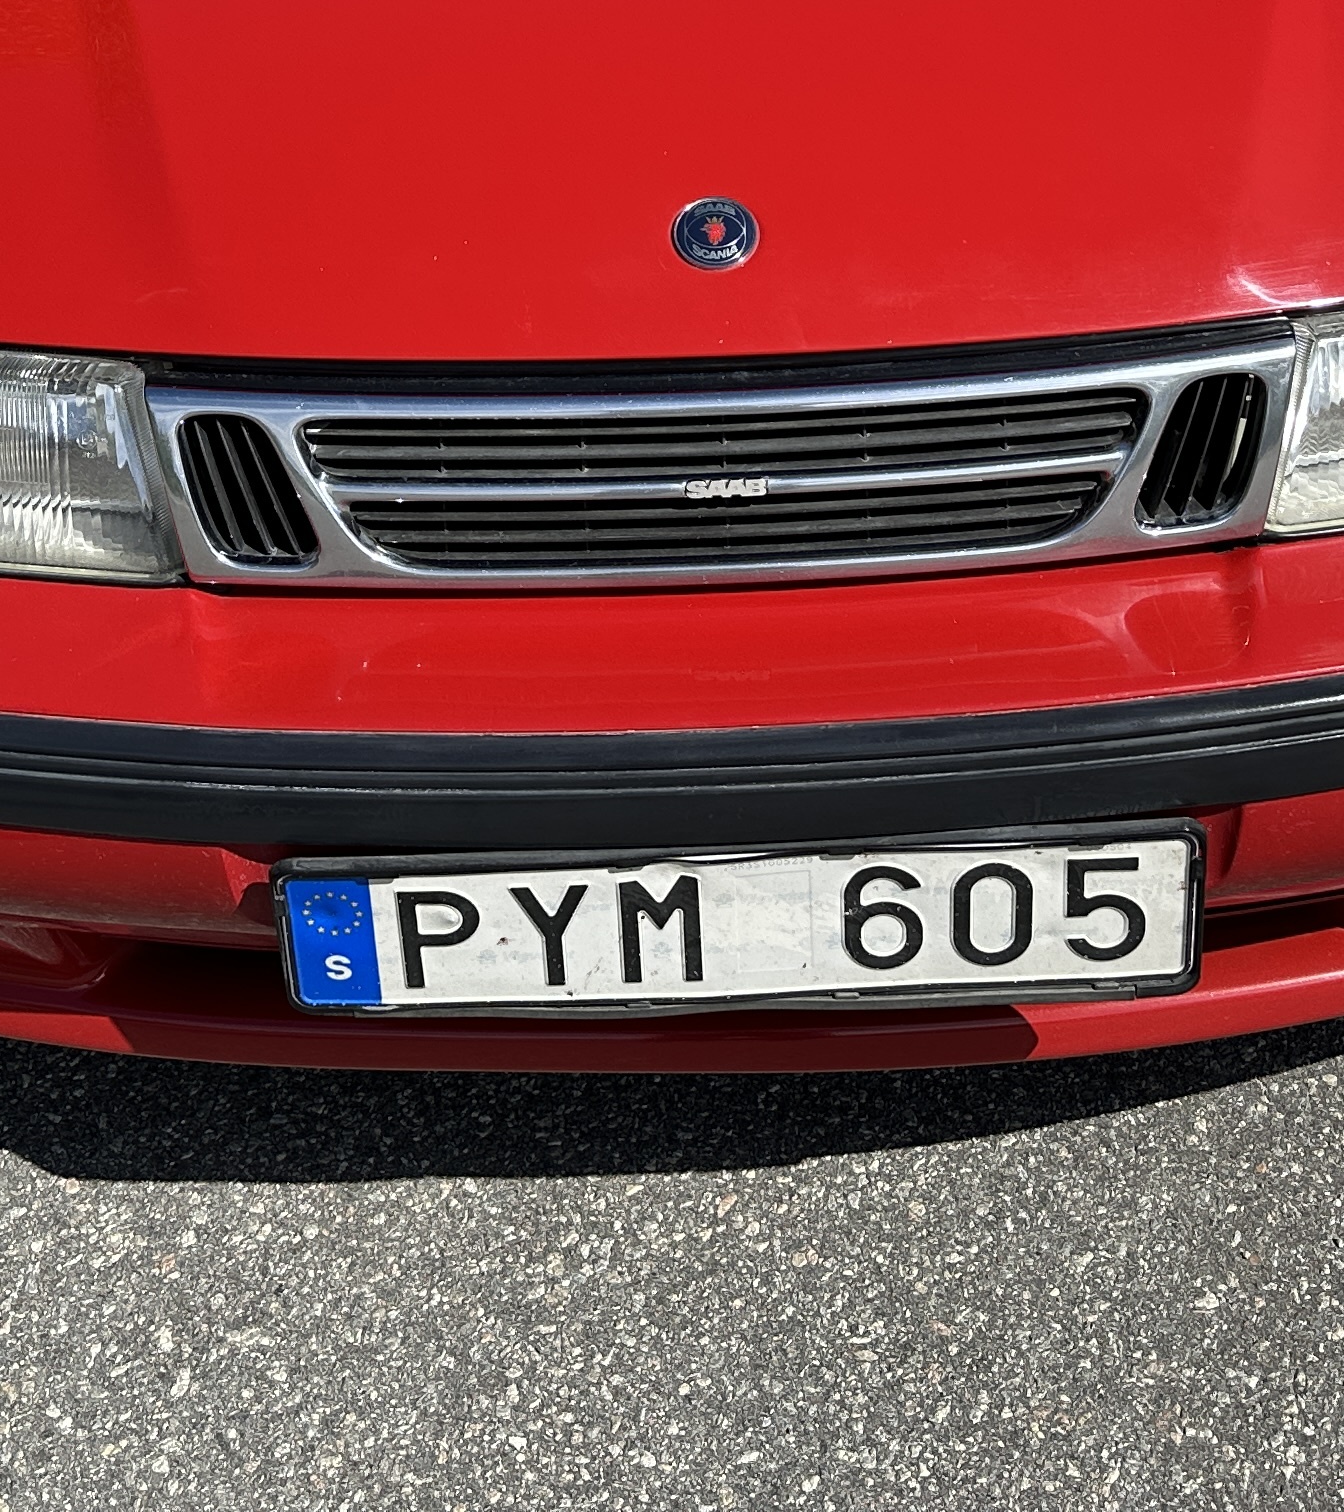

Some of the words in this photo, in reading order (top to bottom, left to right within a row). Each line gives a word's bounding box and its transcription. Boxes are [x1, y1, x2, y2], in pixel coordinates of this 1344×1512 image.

[692, 244, 739, 260] SCANIA
[685, 478, 768, 499] SAAB
[395, 875, 704, 988] PYM
[843, 856, 1147, 970] 605
[324, 954, 353, 981] S
